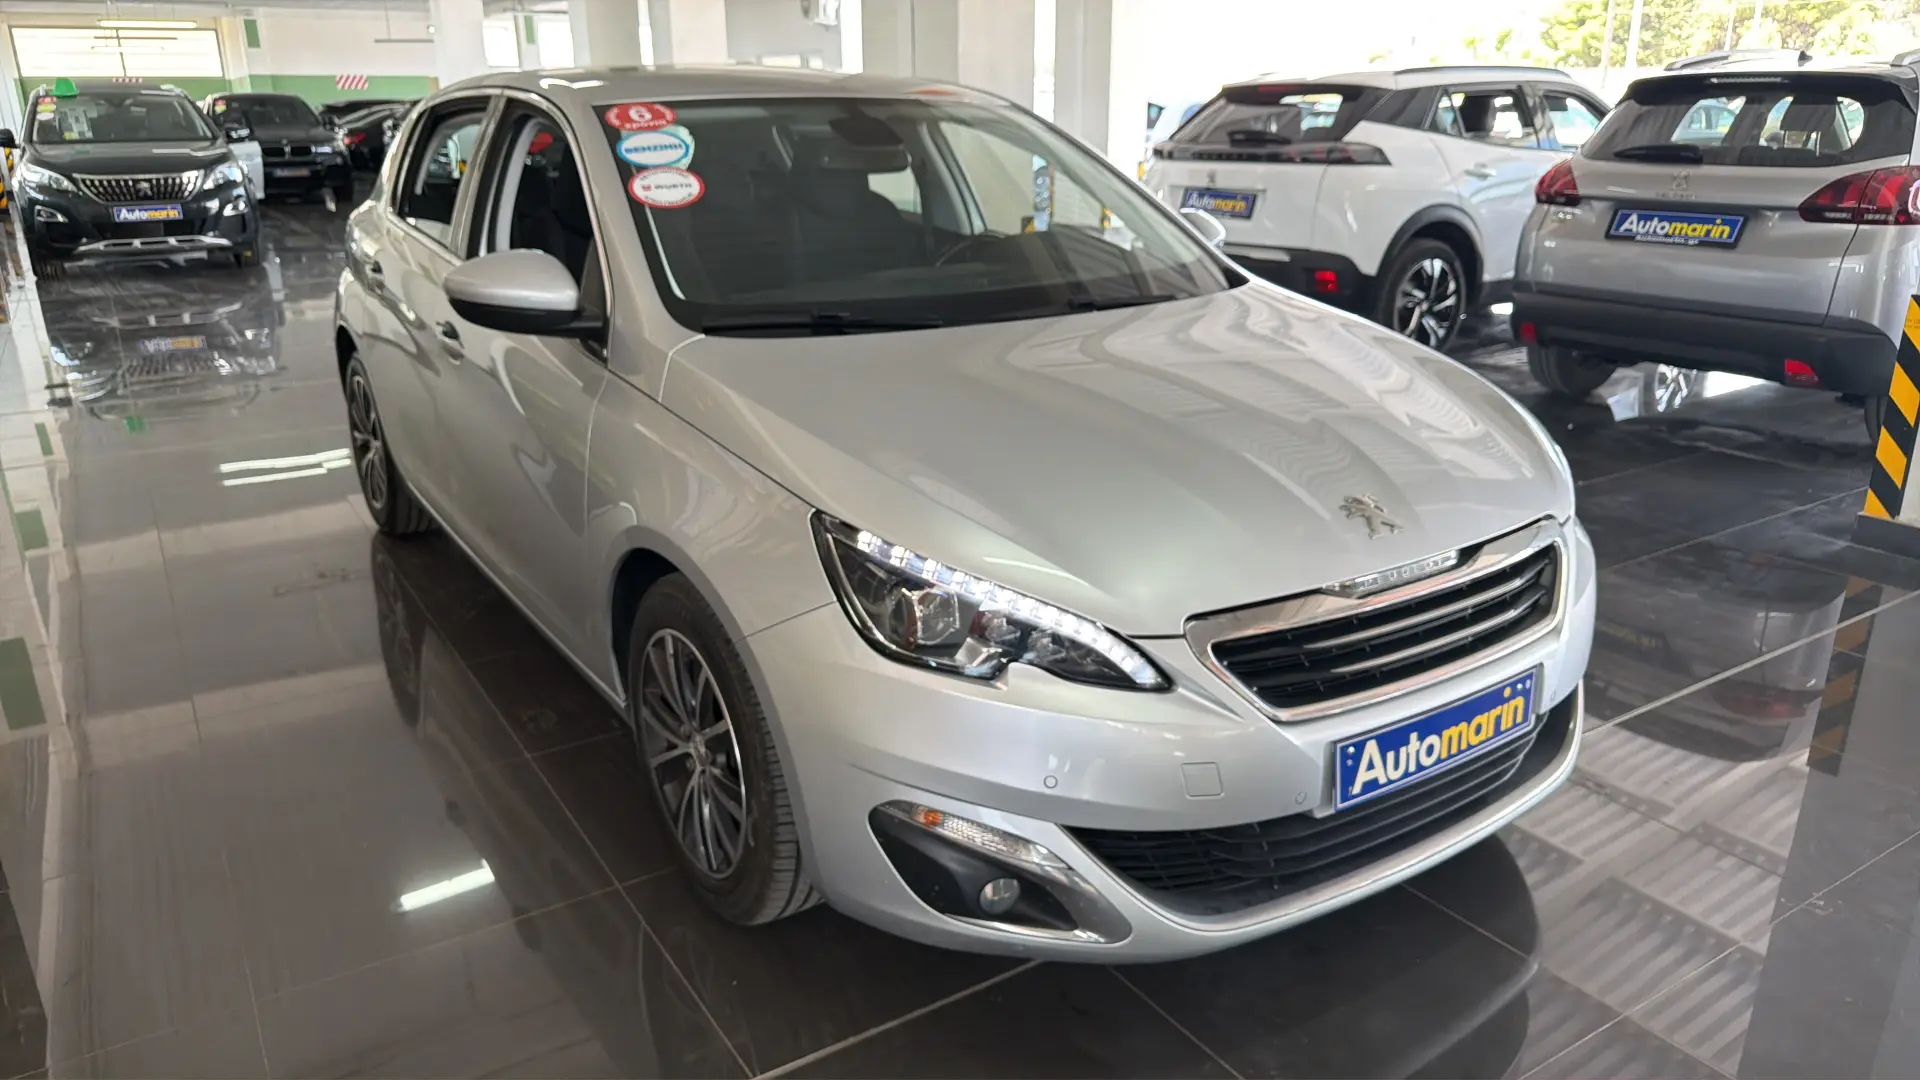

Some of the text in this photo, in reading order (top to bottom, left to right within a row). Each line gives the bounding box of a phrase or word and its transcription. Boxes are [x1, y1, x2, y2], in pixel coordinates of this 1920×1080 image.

[628, 105, 653, 122] 6
[120, 205, 179, 221] Automarin
[1619, 212, 1731, 239] Automarin
[1351, 686, 1525, 795] Automarin
